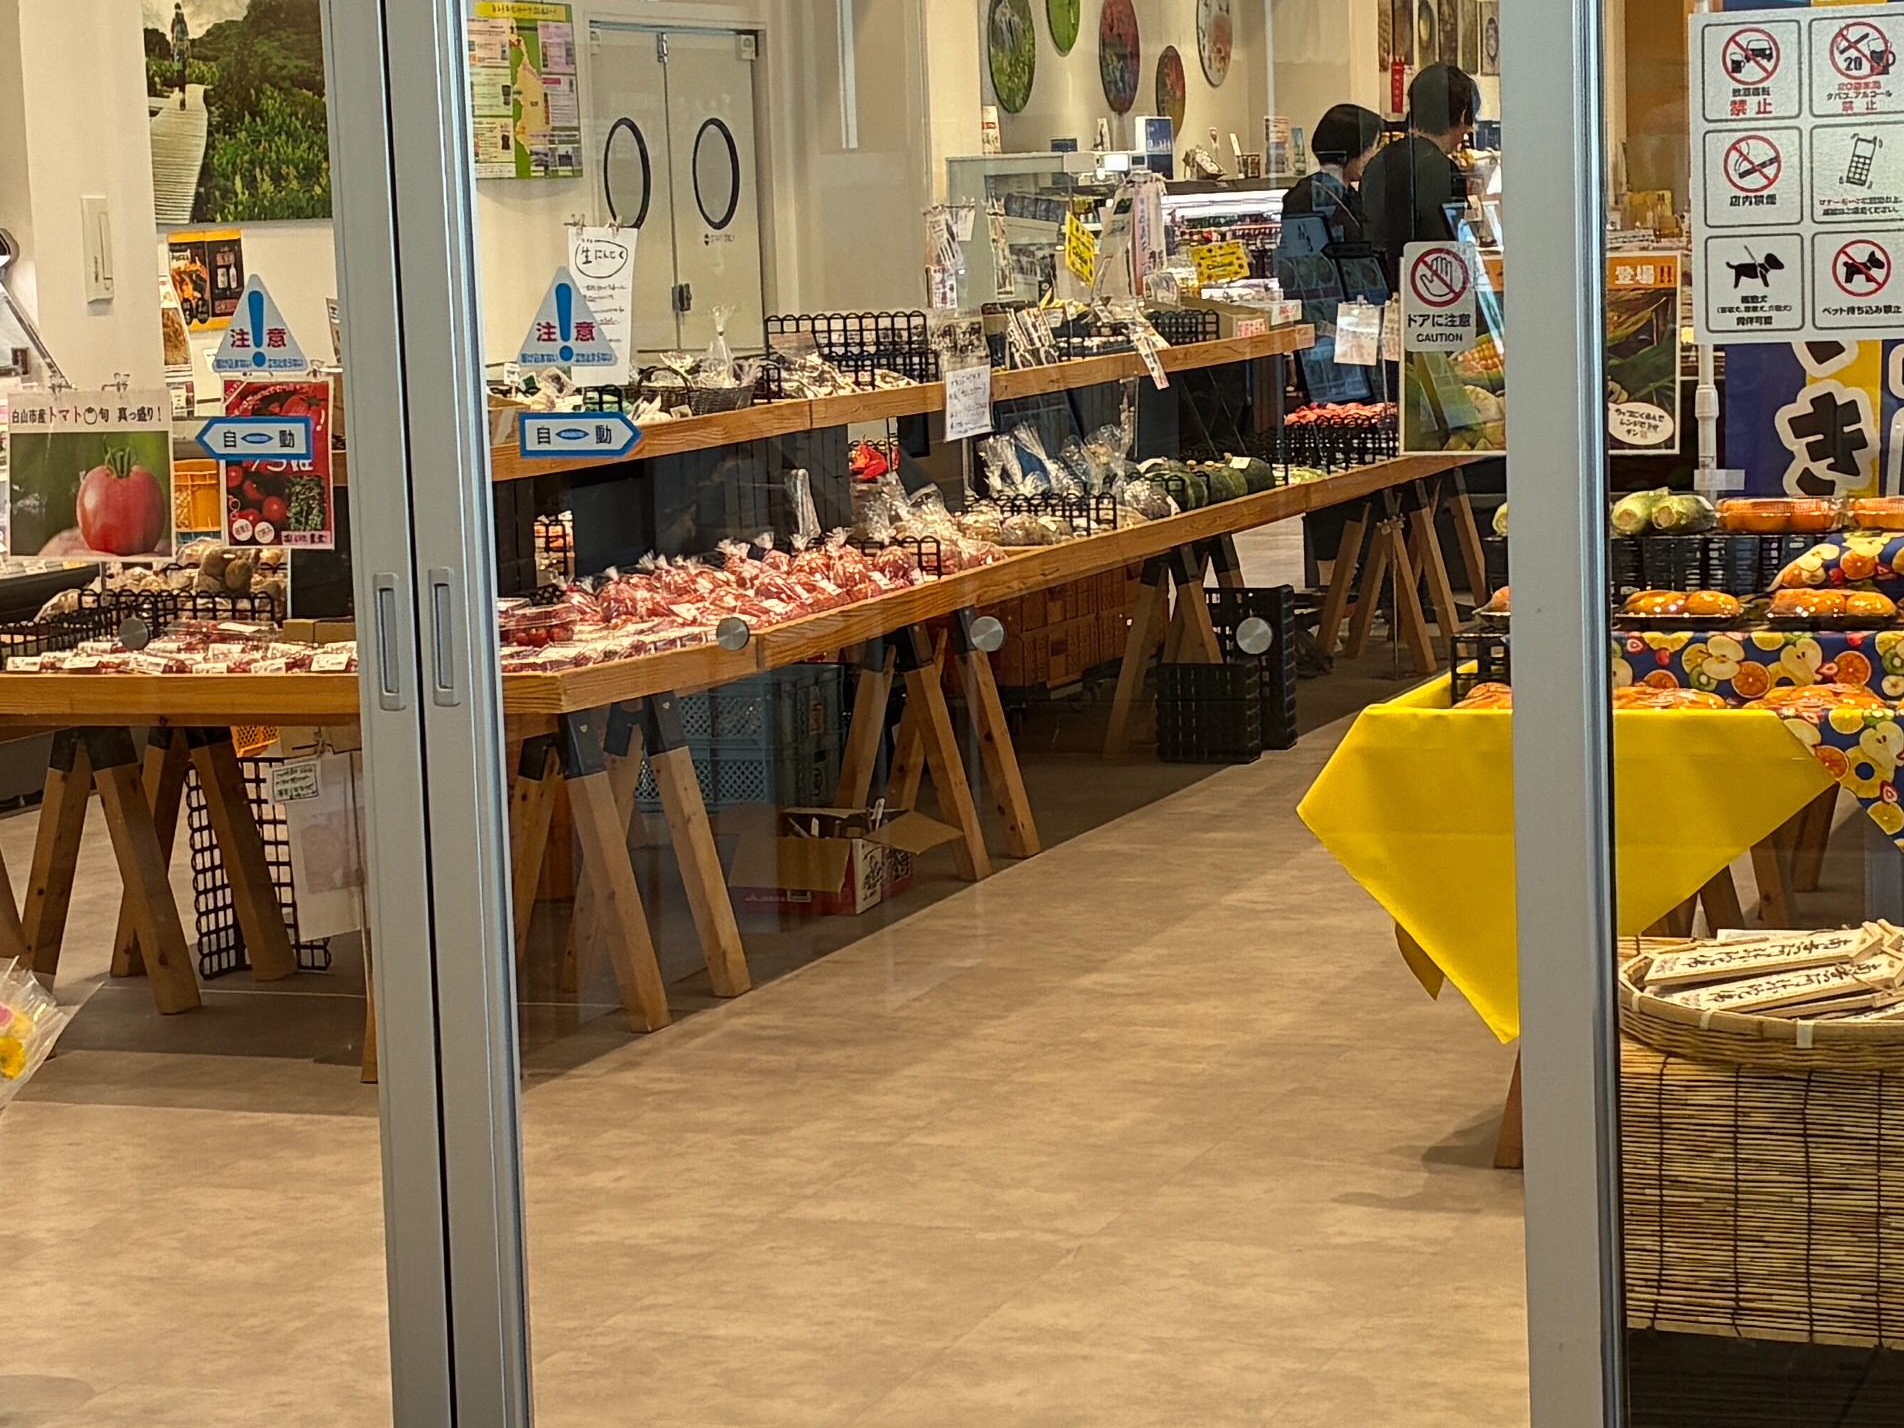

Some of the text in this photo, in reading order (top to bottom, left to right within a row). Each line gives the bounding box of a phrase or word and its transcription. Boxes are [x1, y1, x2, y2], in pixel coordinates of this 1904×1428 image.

[1730, 99, 1773, 116] 禁止
[1842, 100, 1877, 112] 禁止
[1730, 194, 1776, 207] 店内禁煙
[1822, 305, 1902, 315] ペット持ち込み禁止
[1407, 313, 1471, 328] ドアに注意
[1416, 333, 1462, 343] CAUTION
[12, 405, 82, 424] 白山市産トマト
[223, 430, 295, 448] 自動
[537, 425, 612, 445] 自動
